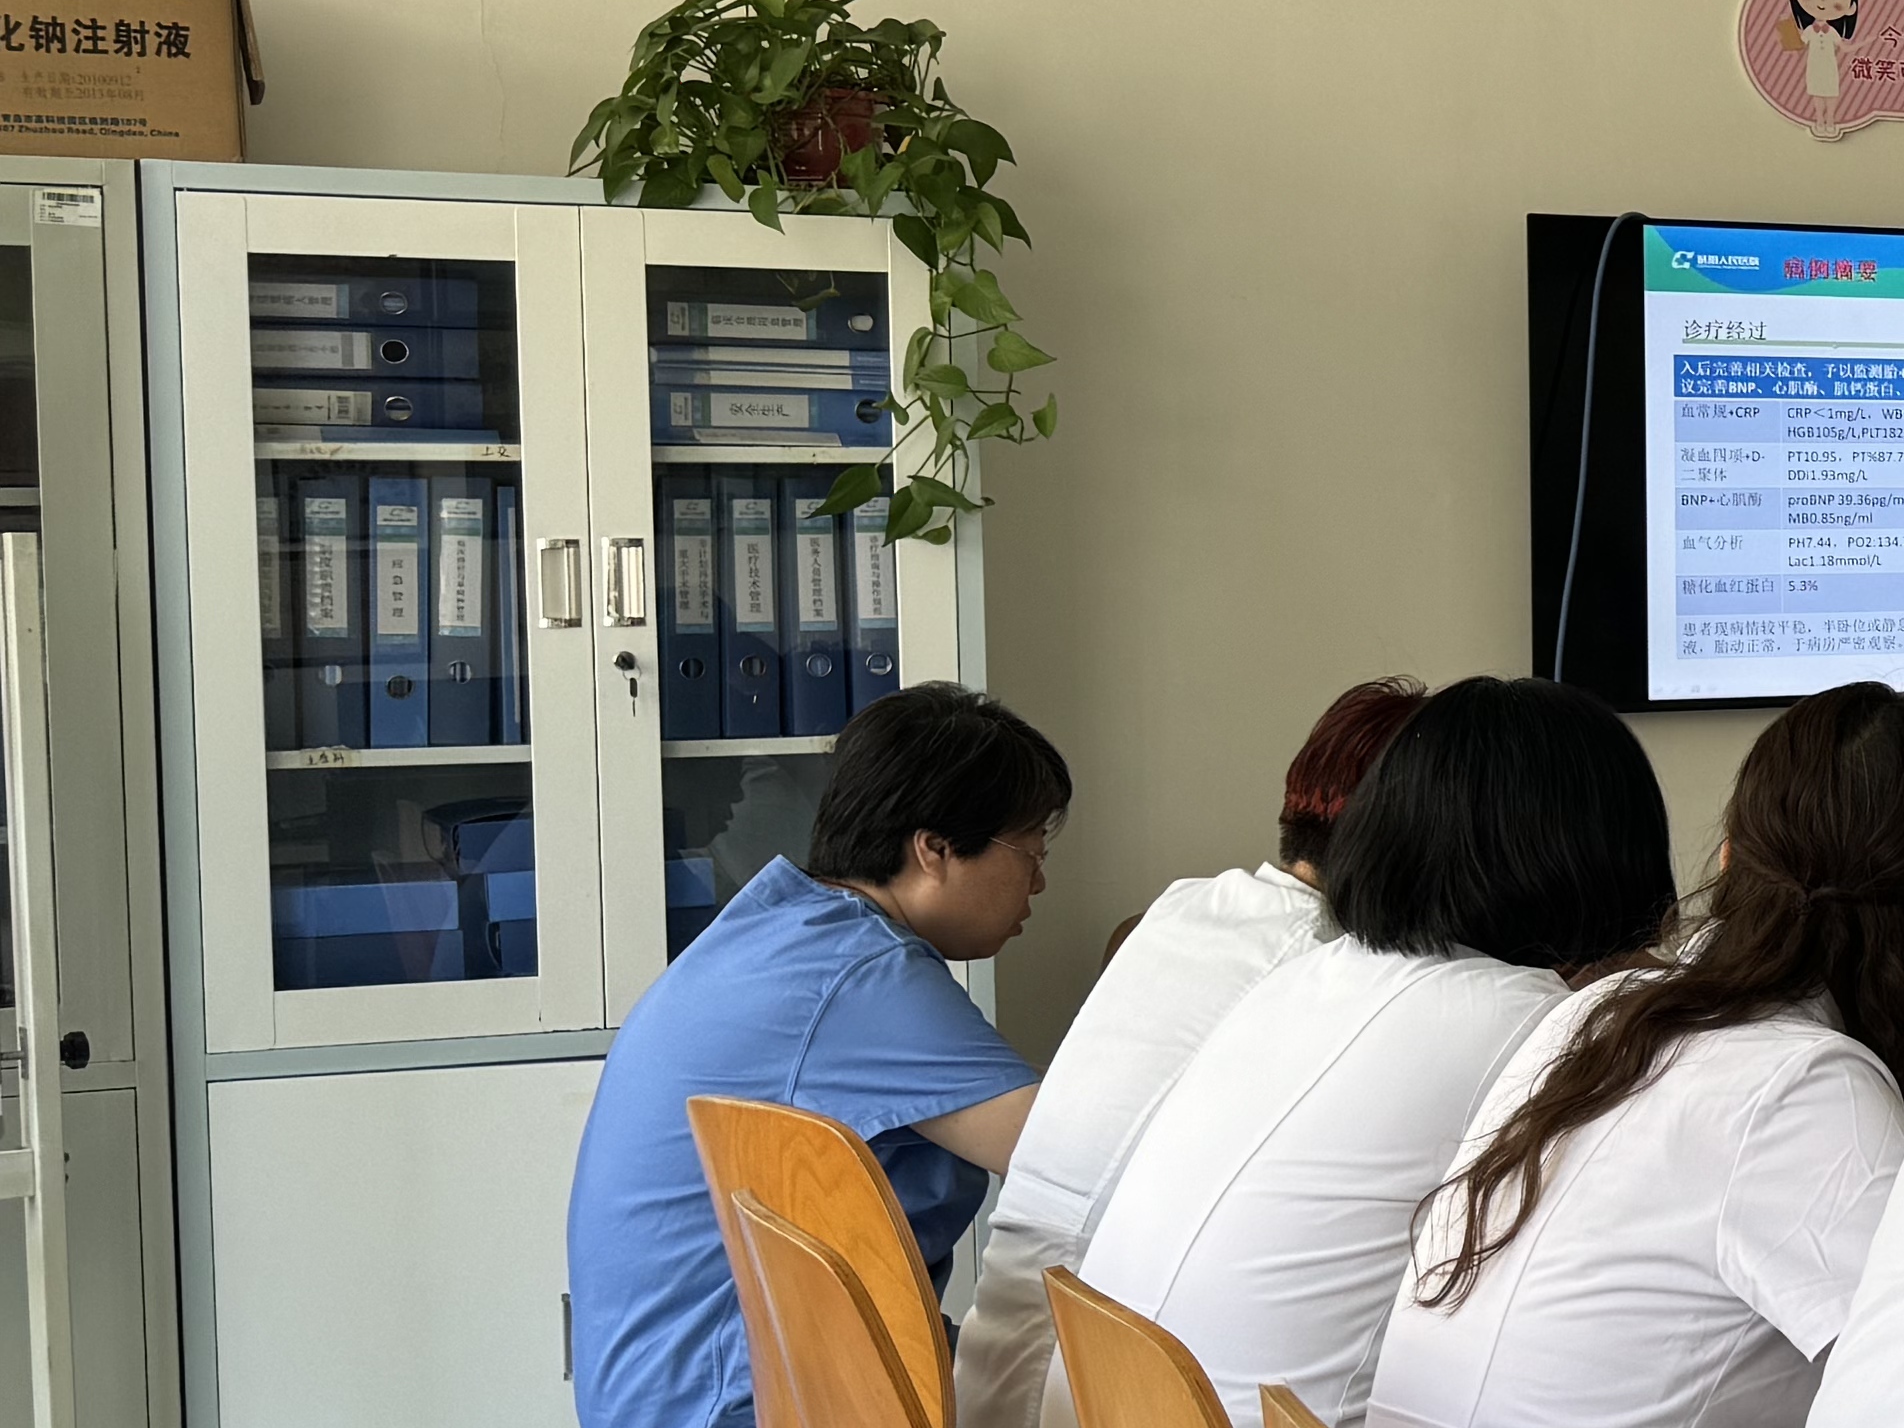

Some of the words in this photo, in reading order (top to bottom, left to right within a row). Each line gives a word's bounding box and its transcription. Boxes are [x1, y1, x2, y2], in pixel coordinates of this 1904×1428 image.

[150, 129, 180, 138] China
[1784, 257, 1878, 282] 病例摘要
[1684, 320, 1767, 340] 诊疗经过
[729, 403, 791, 418] 安全生产
[1681, 467, 1727, 481] 二聚体
[1682, 535, 1744, 551] 血气分析
[747, 542, 762, 614] 医疗技术管理
[1788, 580, 1818, 592] 5.3%
[1682, 578, 1775, 595] 糖化血红蛋白
